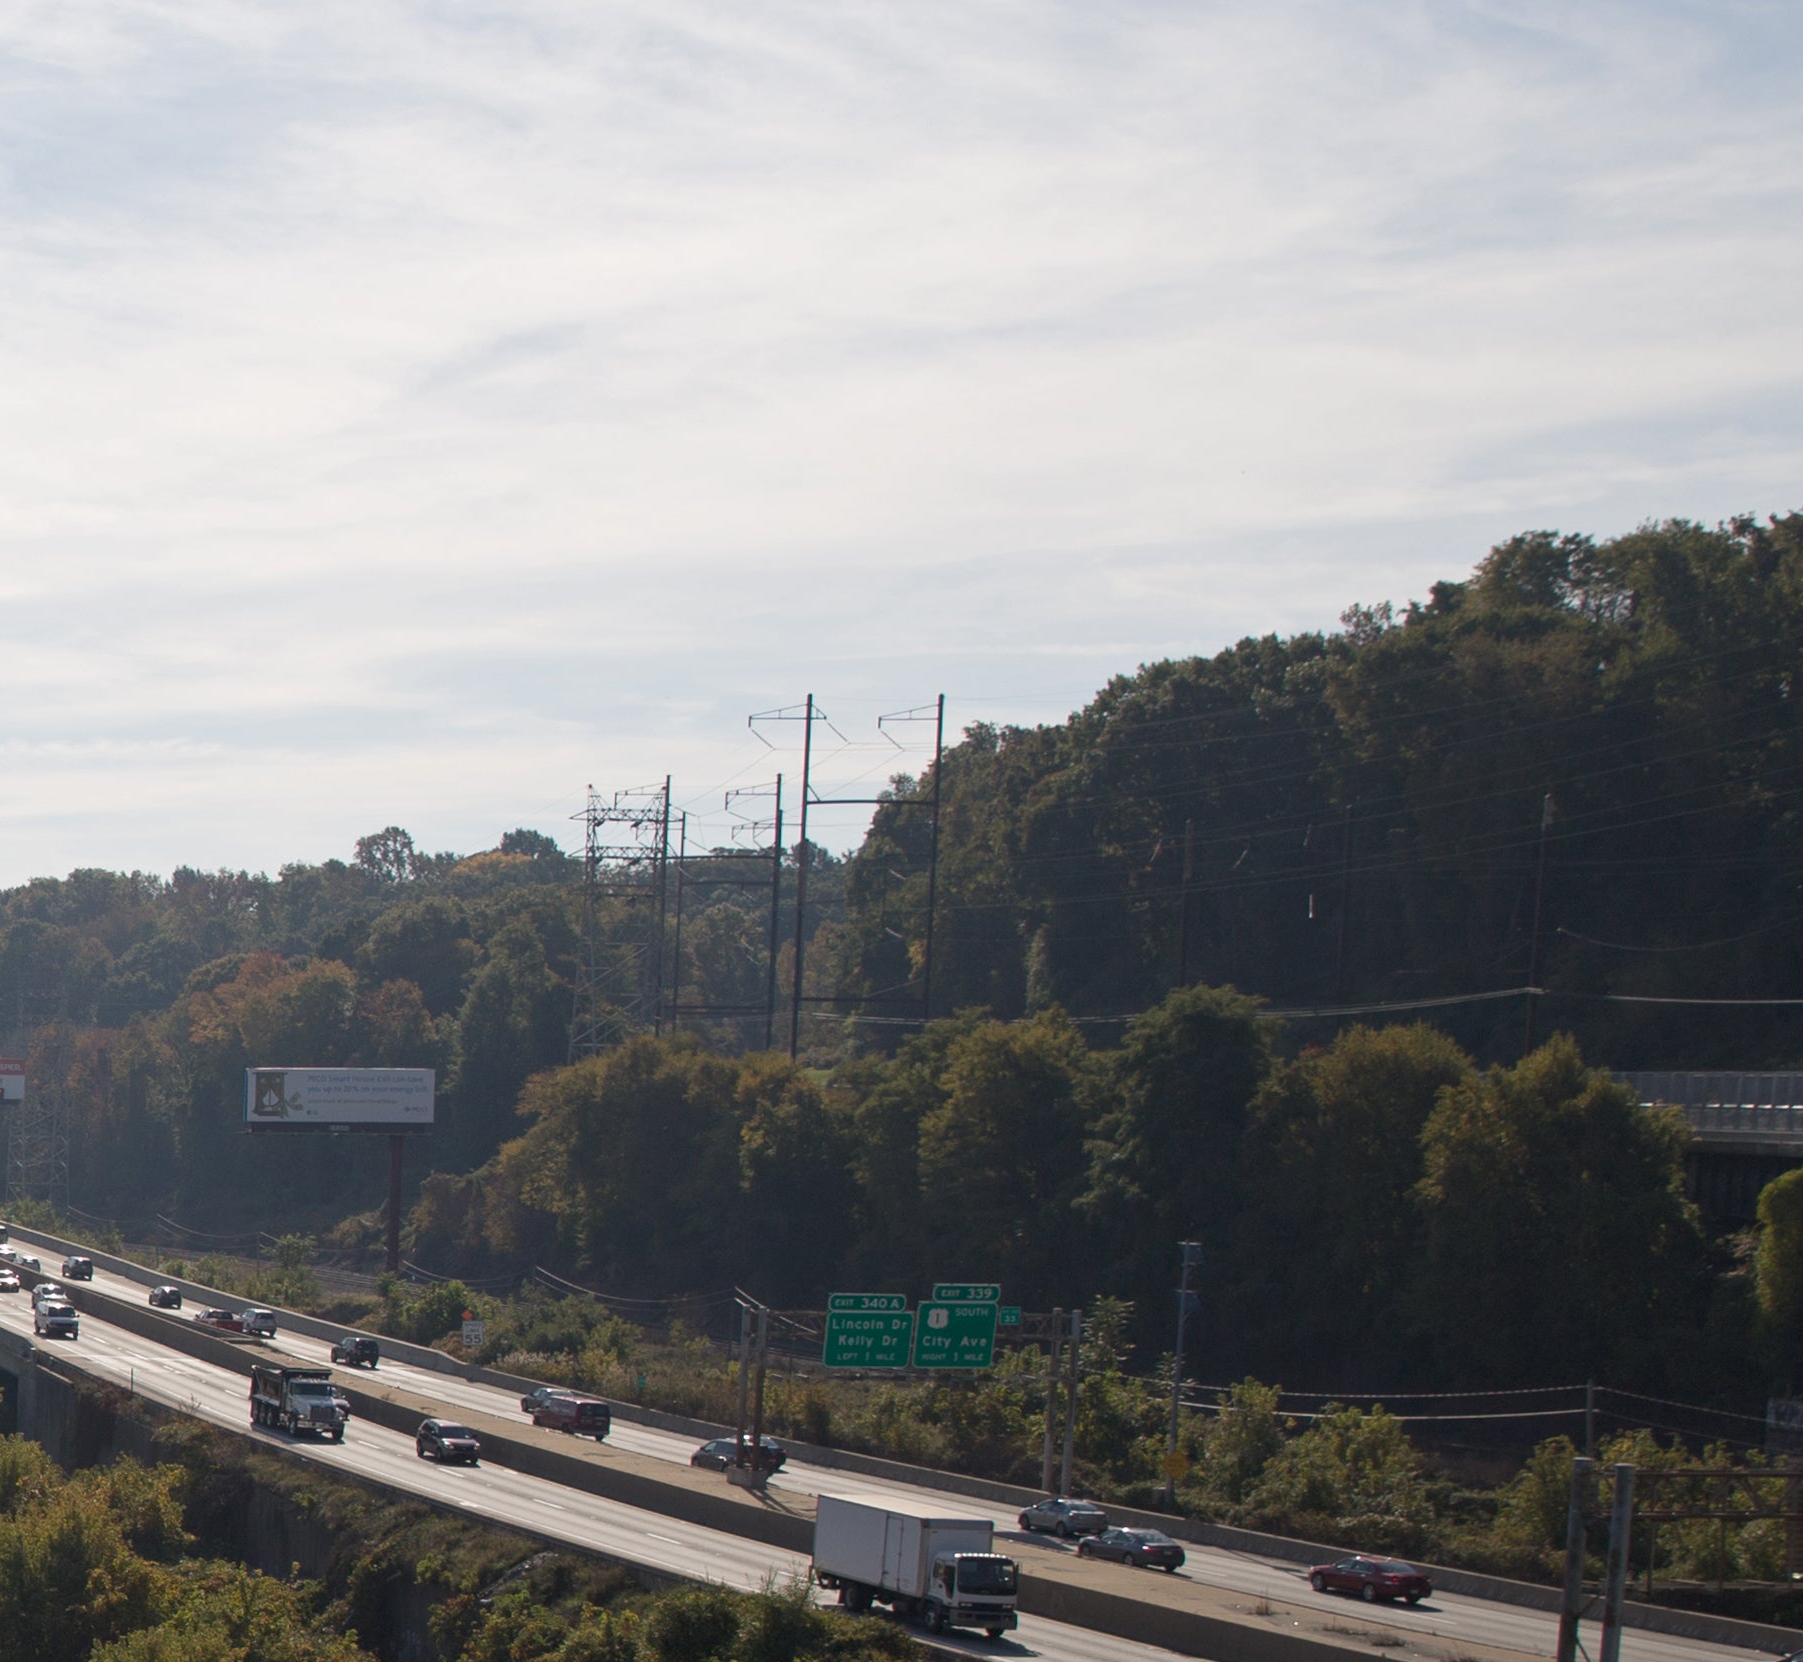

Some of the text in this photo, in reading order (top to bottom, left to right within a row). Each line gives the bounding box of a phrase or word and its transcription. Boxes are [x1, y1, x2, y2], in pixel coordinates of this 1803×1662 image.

[941, 1288, 993, 1299] EXIT 339
[861, 1298, 888, 1308] 340
[890, 1299, 900, 1308] A
[955, 1307, 989, 1317] SOUTH
[935, 1312, 940, 1324] 1
[832, 1319, 908, 1329] Lincoln Dr
[465, 1334, 481, 1344] 55
[838, 1335, 898, 1348] Kelly Dr
[922, 1336, 987, 1349] City Ave
